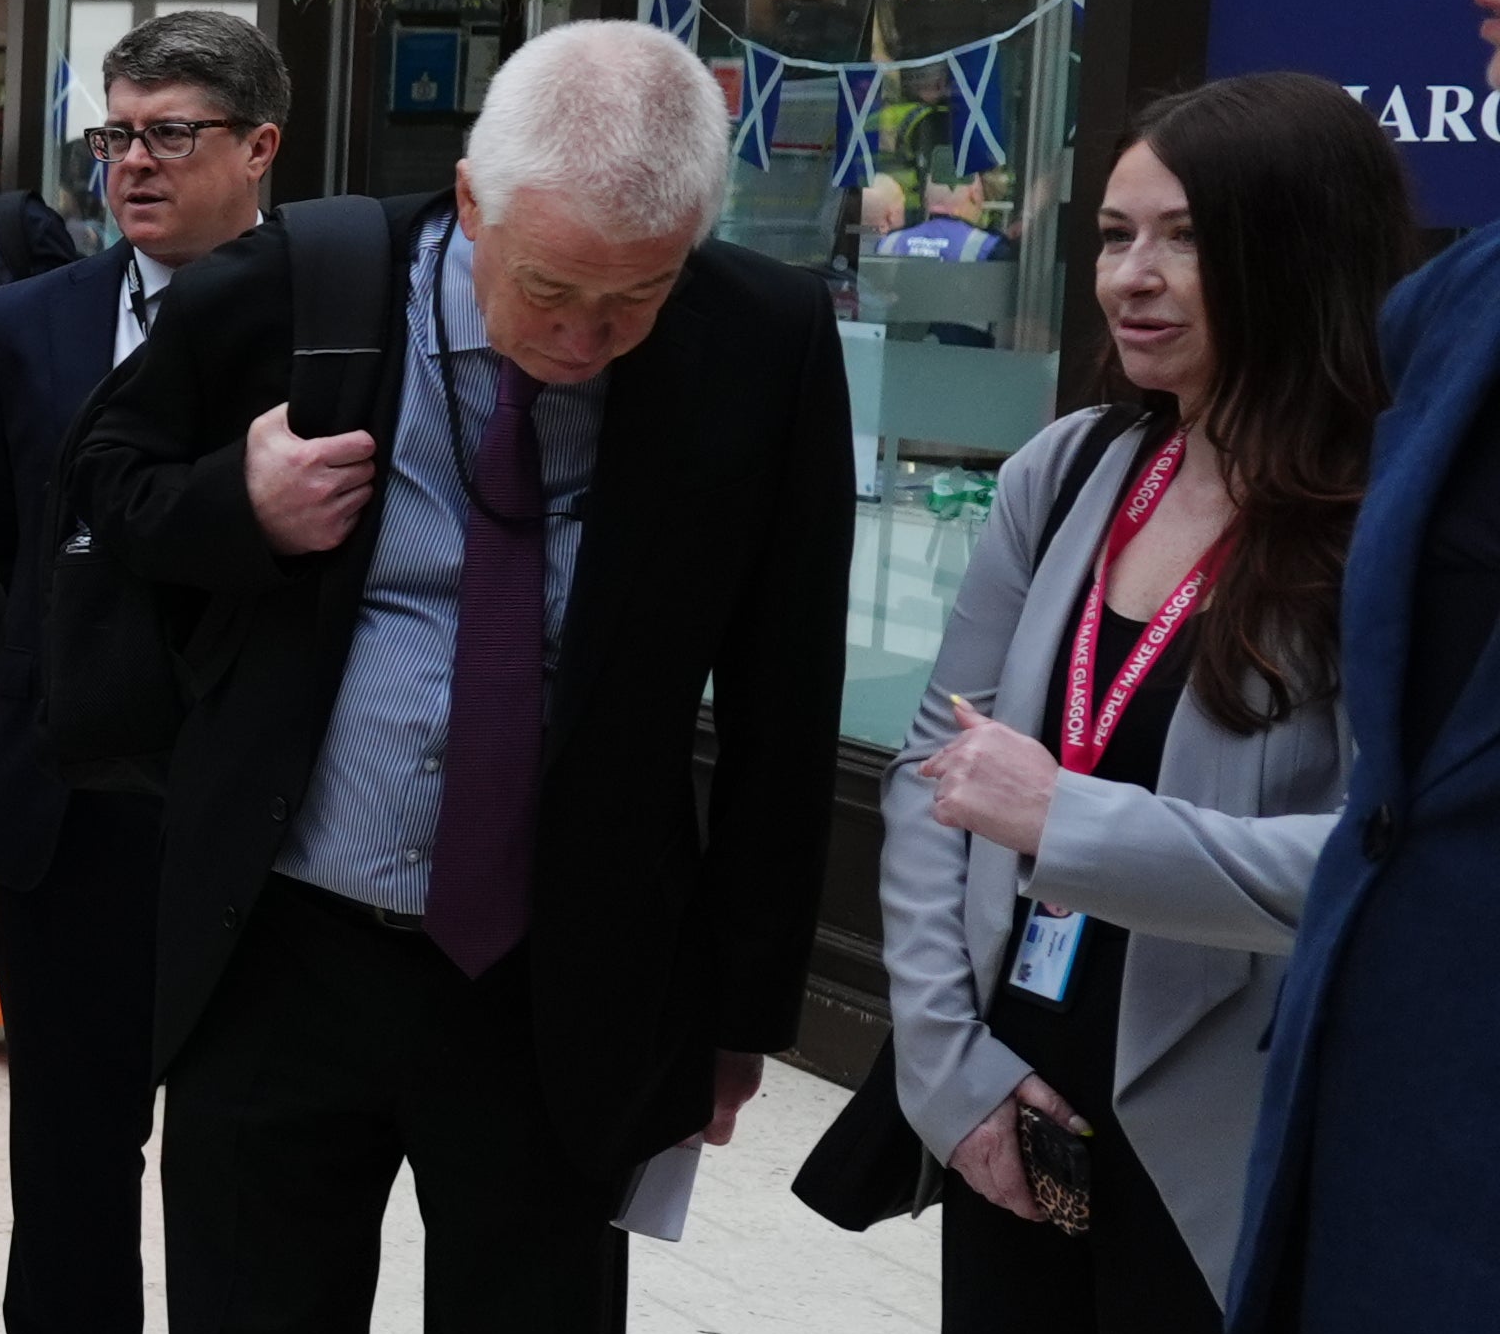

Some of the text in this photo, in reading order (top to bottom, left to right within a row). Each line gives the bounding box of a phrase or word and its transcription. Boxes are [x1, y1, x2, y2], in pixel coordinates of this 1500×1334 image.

[1343, 84, 1500, 142] AR
[1125, 456, 1173, 523] GLASGOW
[1077, 623, 1094, 666] MAKE
[1093, 570, 1208, 747] PEOPLE MAKE GLASGOW
[1067, 667, 1087, 747] GLASGOW
